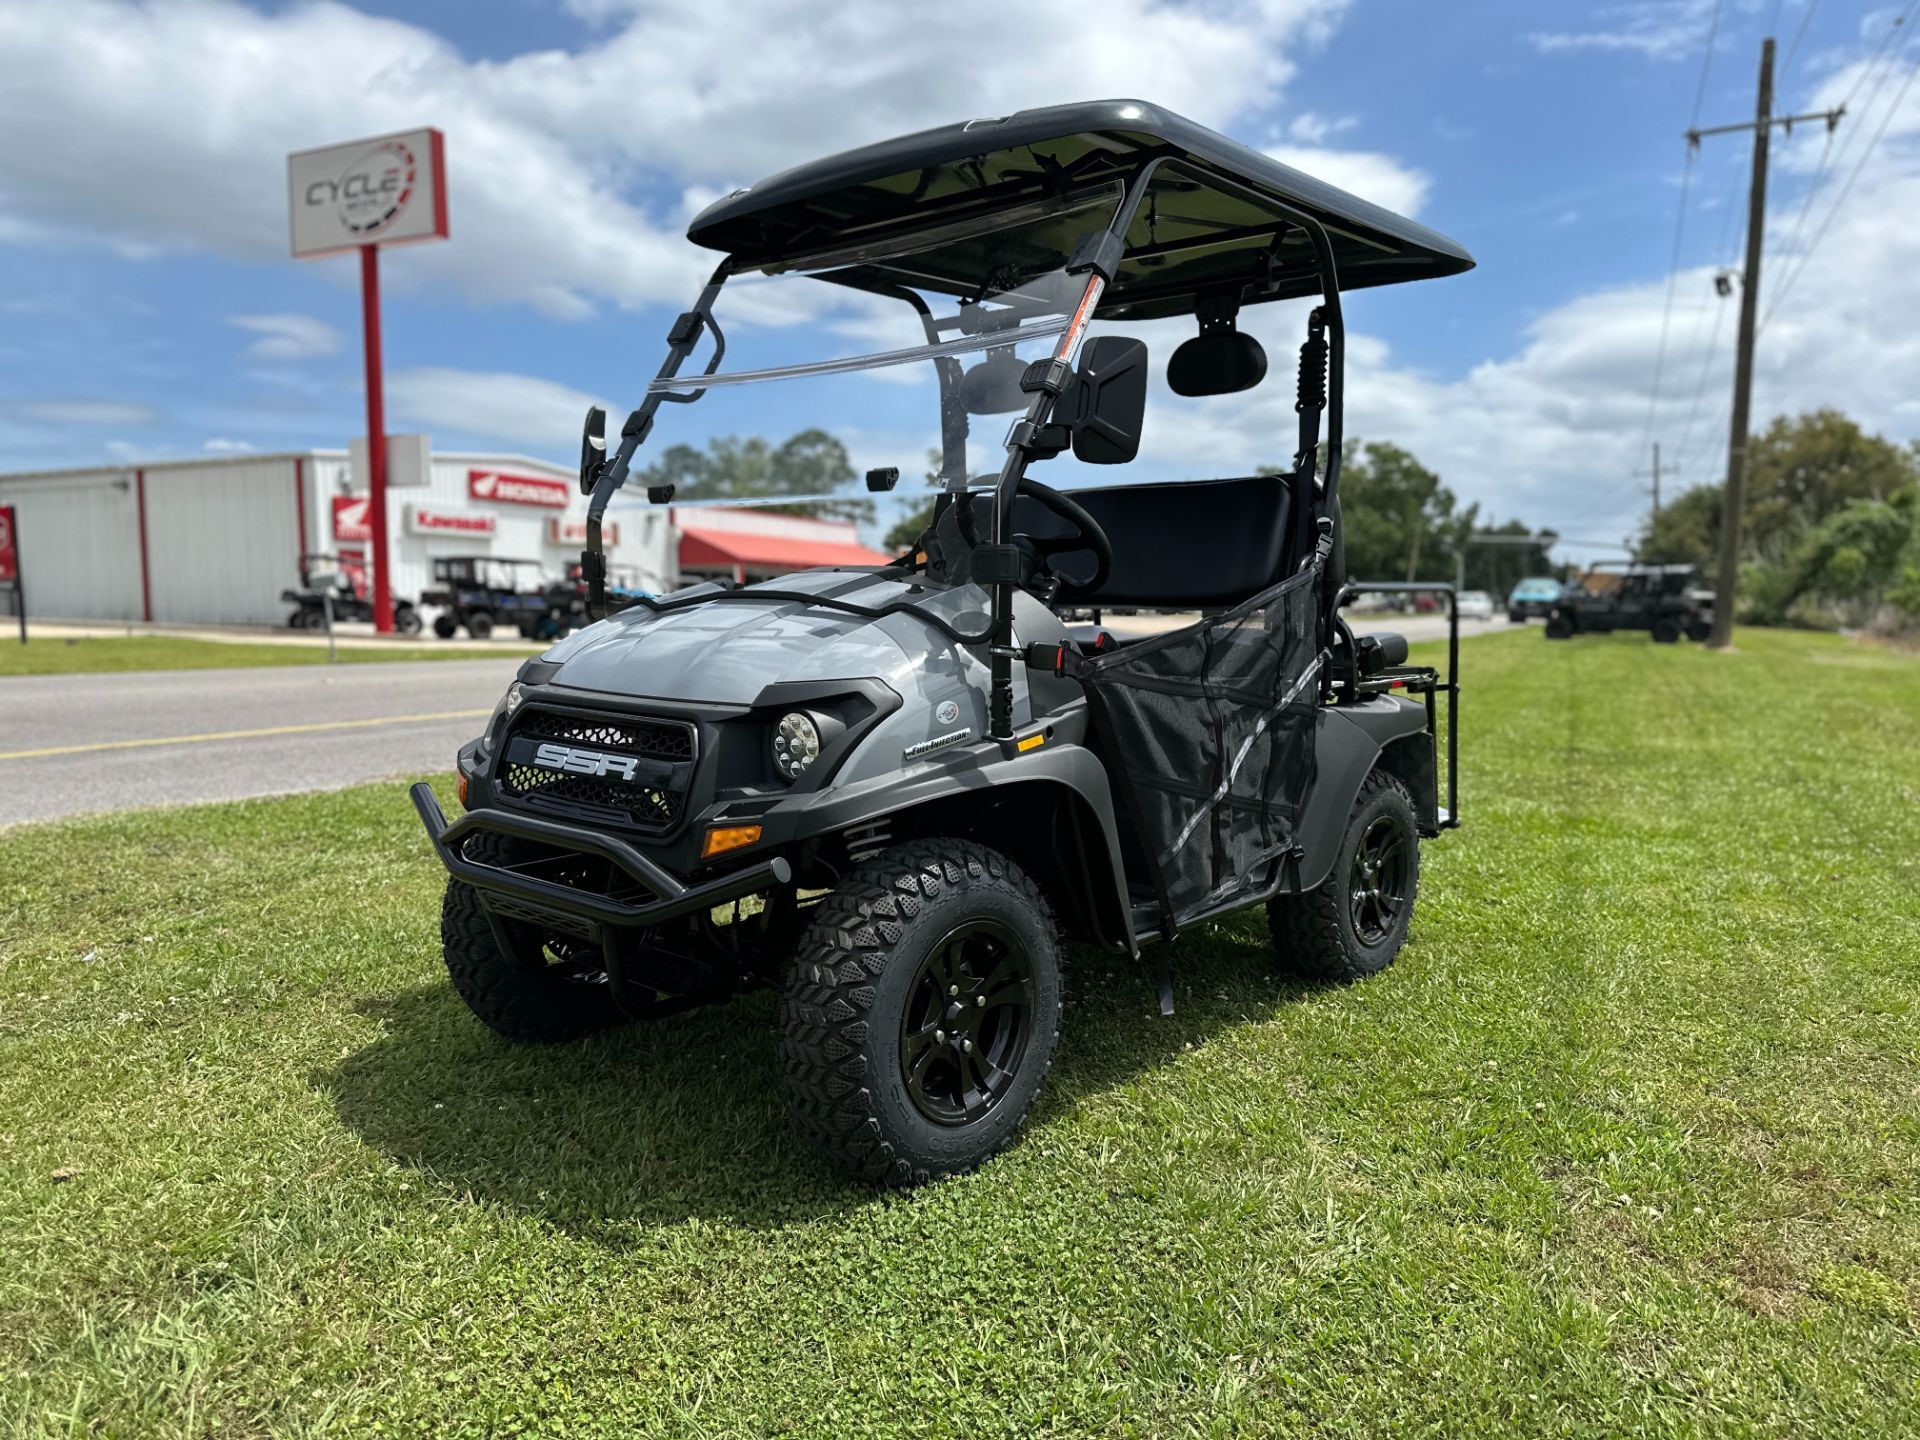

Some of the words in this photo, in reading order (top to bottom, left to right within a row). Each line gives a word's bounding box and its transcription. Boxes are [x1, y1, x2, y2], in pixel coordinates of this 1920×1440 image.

[305, 168, 399, 206] CYCLE
[497, 481, 566, 505] HONDA
[417, 509, 496, 533] Kawasaki
[534, 743, 639, 780] SSR
